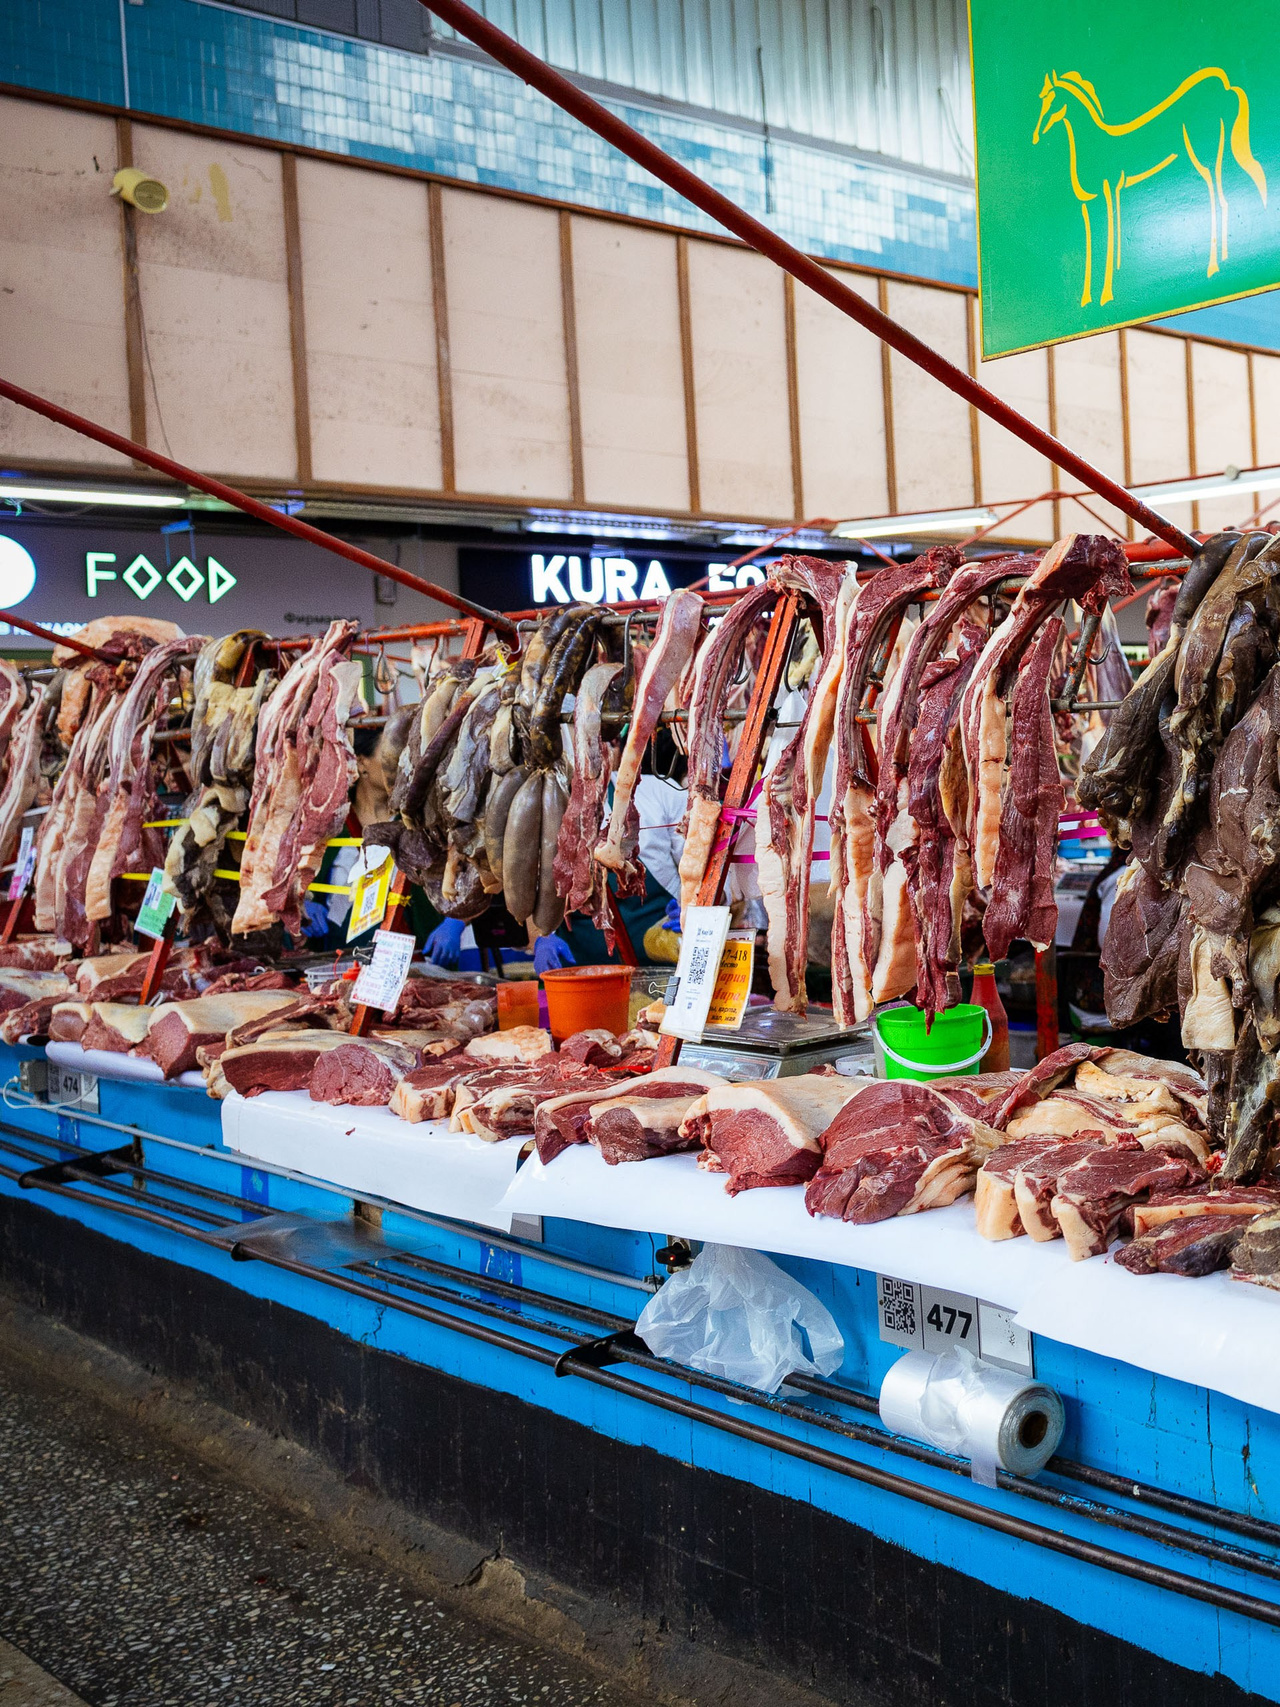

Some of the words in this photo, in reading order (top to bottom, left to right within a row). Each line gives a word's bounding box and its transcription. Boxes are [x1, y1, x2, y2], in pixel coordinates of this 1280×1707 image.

[86, 552, 238, 604] FOOD
[531, 554, 672, 604] KURA
[708, 563, 766, 593] FO
[63, 1075, 79, 1095] 474
[926, 1303, 973, 1339] 477
